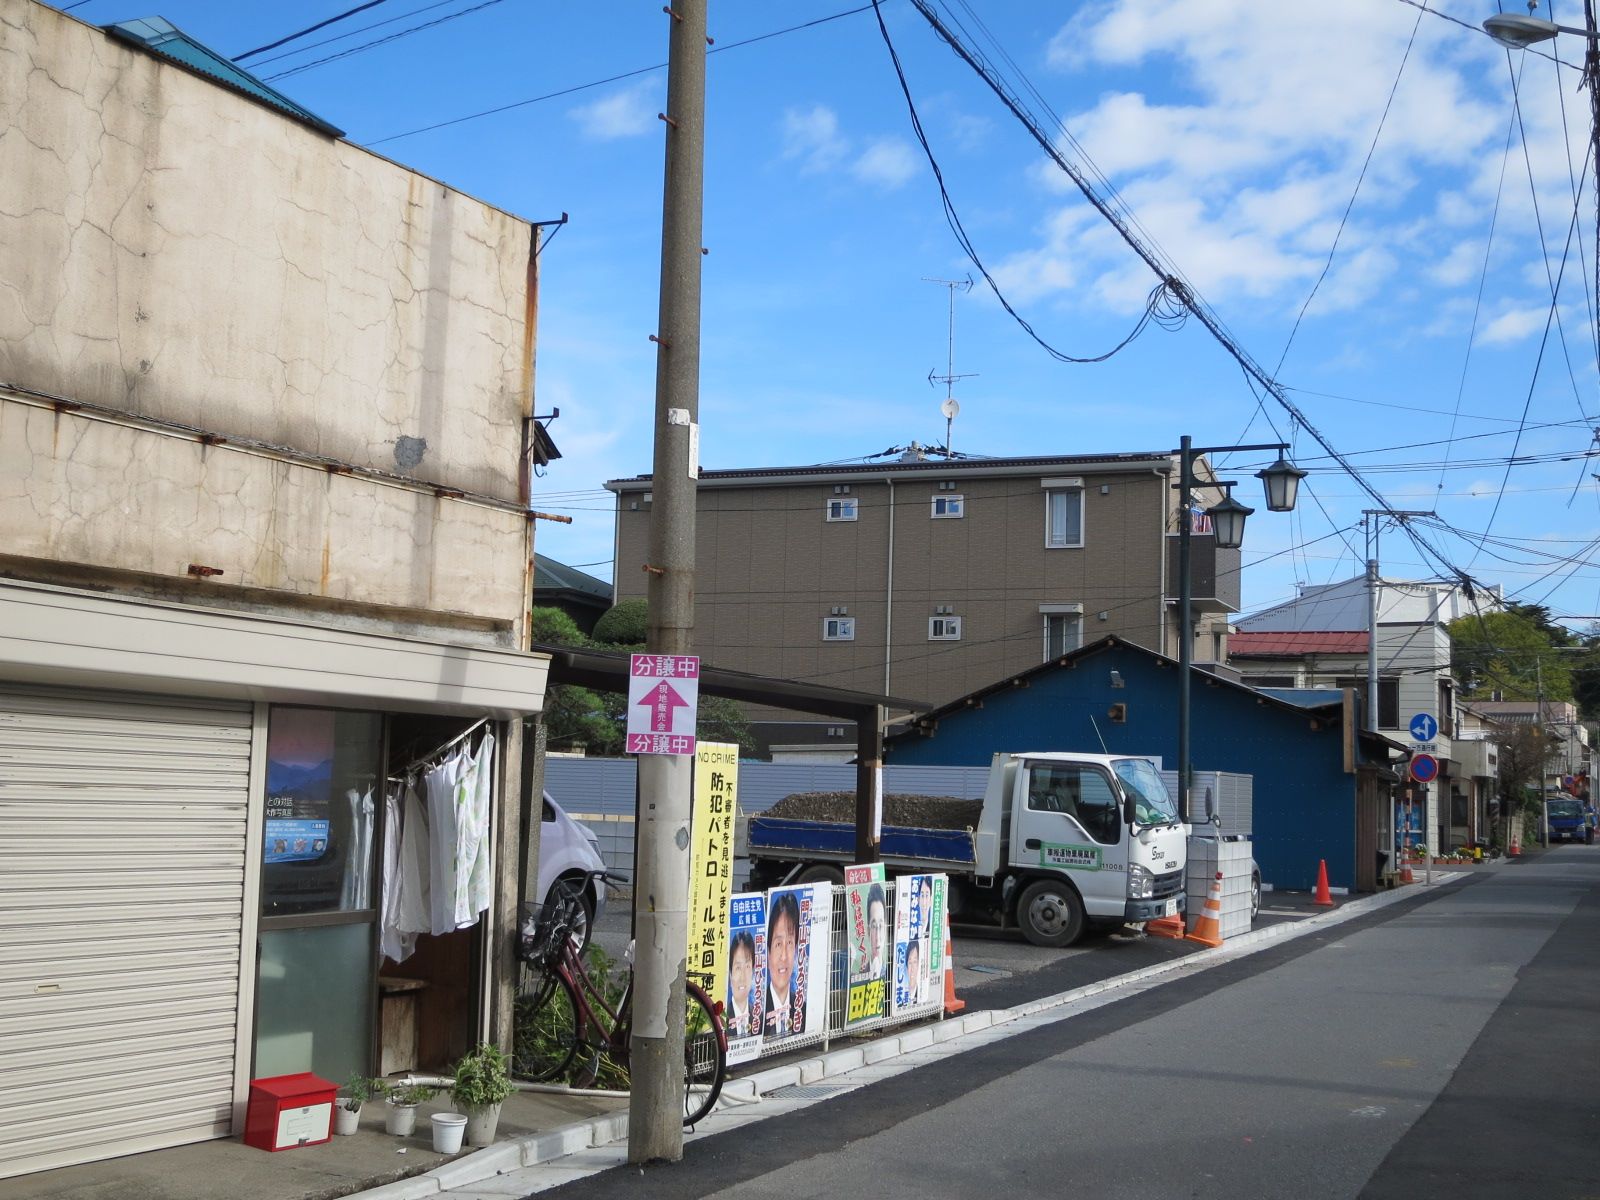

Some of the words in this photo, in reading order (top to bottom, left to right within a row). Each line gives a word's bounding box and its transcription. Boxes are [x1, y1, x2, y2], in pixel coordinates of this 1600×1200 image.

[635, 656, 695, 677] 分譲中
[634, 734, 688, 753] 分譲中
[698, 752, 709, 763] NO
[711, 753, 735, 764] CRIME
[267, 796, 293, 806] との対話
[733, 899, 762, 914] 自由民主党
[738, 913, 757, 925] 広報板
